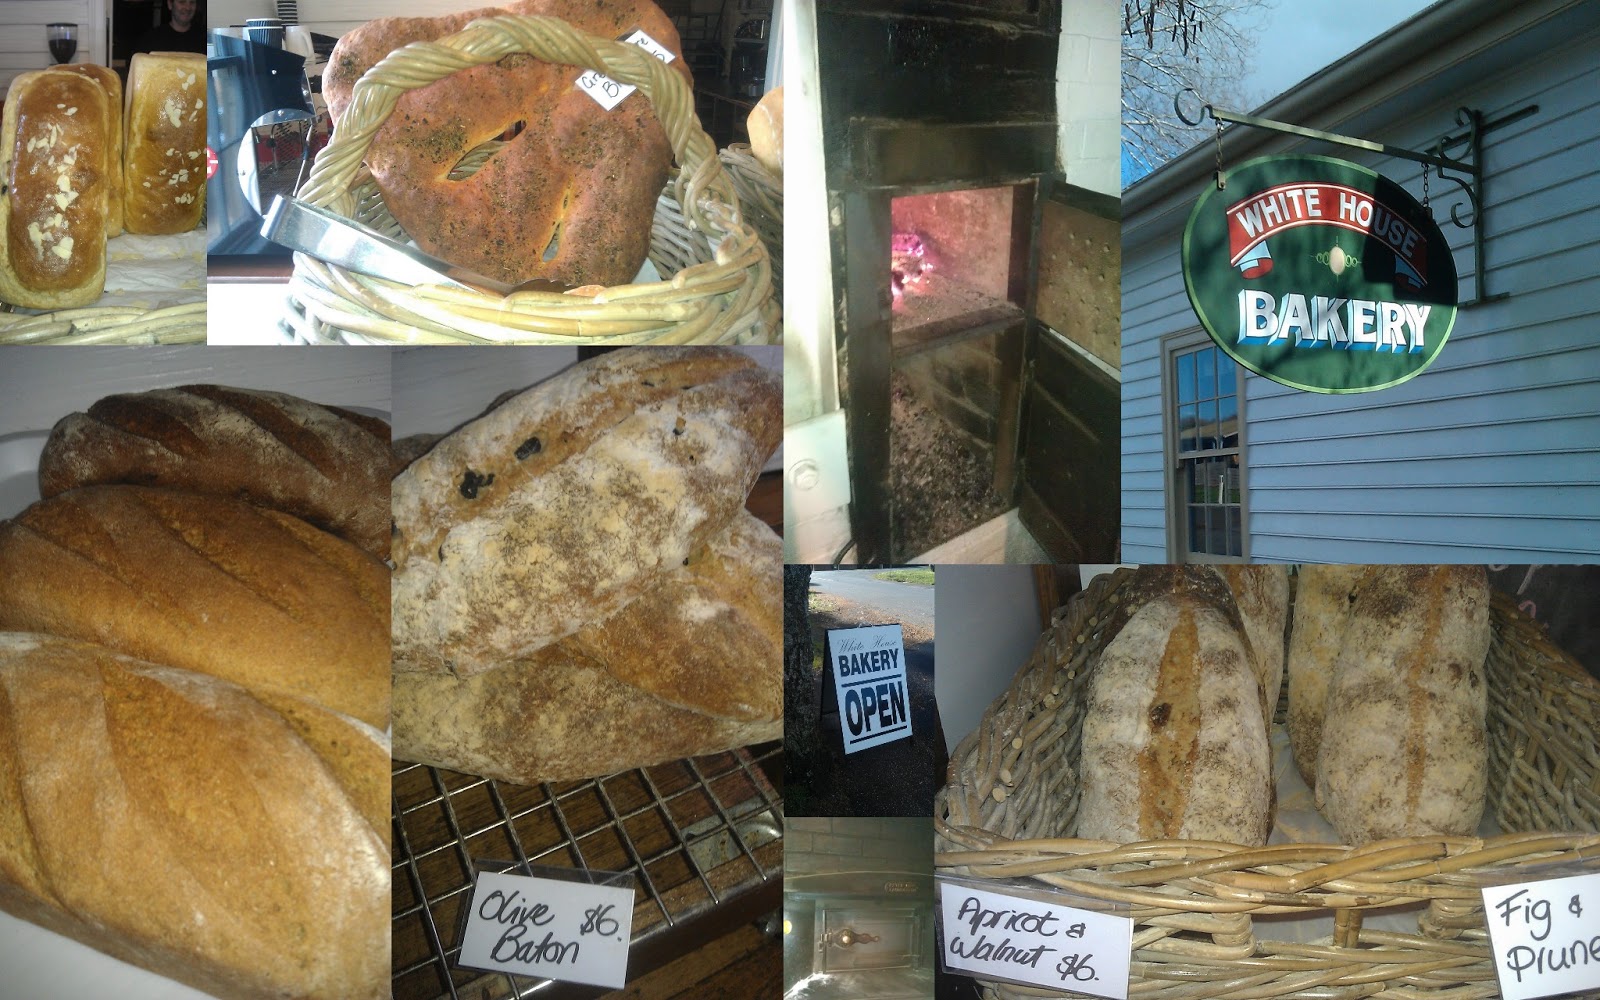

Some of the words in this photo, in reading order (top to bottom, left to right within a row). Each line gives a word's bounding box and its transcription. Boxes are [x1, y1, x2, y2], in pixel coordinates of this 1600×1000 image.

[1236, 188, 1323, 239] WHITE
[1339, 191, 1419, 258] HOUSE
[1237, 288, 1432, 354] BAKERY
[837, 637, 865, 654] White
[838, 647, 899, 677] BAKERY
[844, 681, 906, 737] OPEN
[478, 890, 555, 926] Olive
[957, 896, 1060, 936] Apricot
[1495, 888, 1552, 942] Fig
[489, 924, 580, 965] Baton
